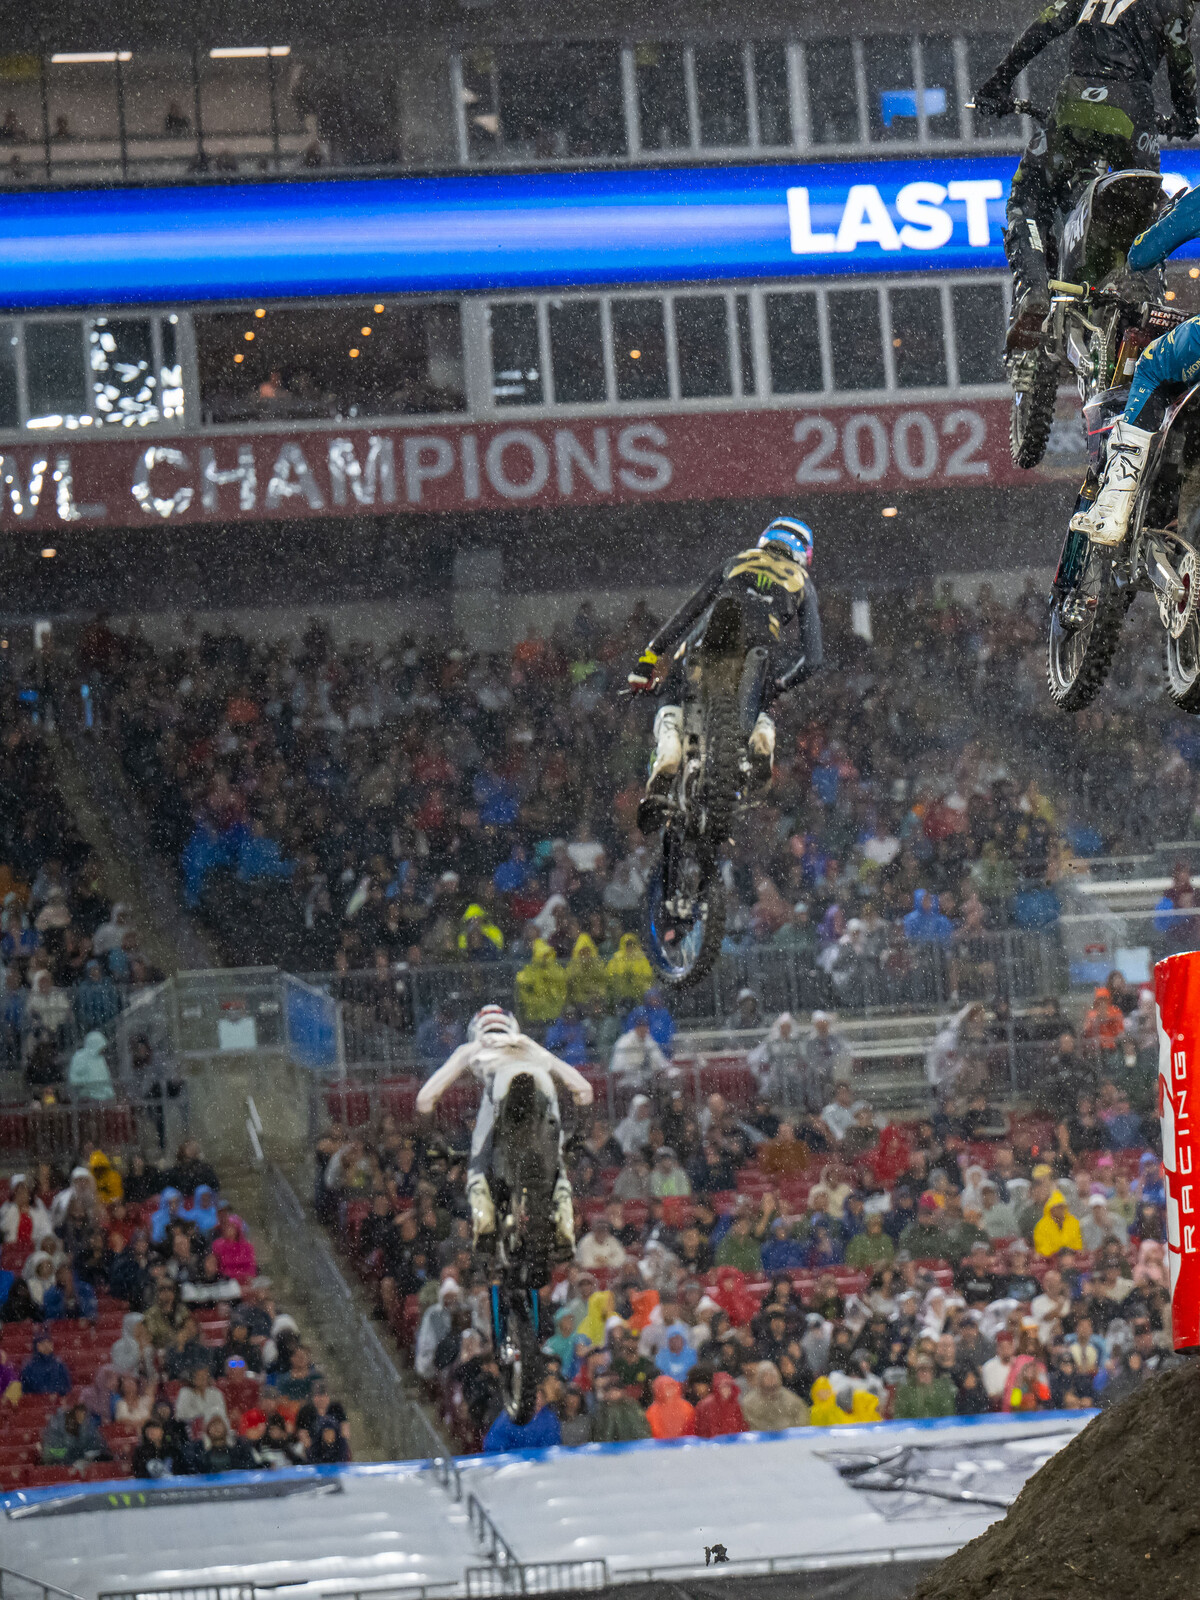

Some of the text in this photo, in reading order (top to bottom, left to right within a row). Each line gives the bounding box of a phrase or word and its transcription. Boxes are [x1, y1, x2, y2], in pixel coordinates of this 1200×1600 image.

[786, 179, 1003, 254] LAST
[1150, 310, 1188, 322] RENTH
[132, 422, 673, 518] CHAMPIONS
[793, 408, 990, 484] 2002
[1173, 1050, 1197, 1255] RACING
